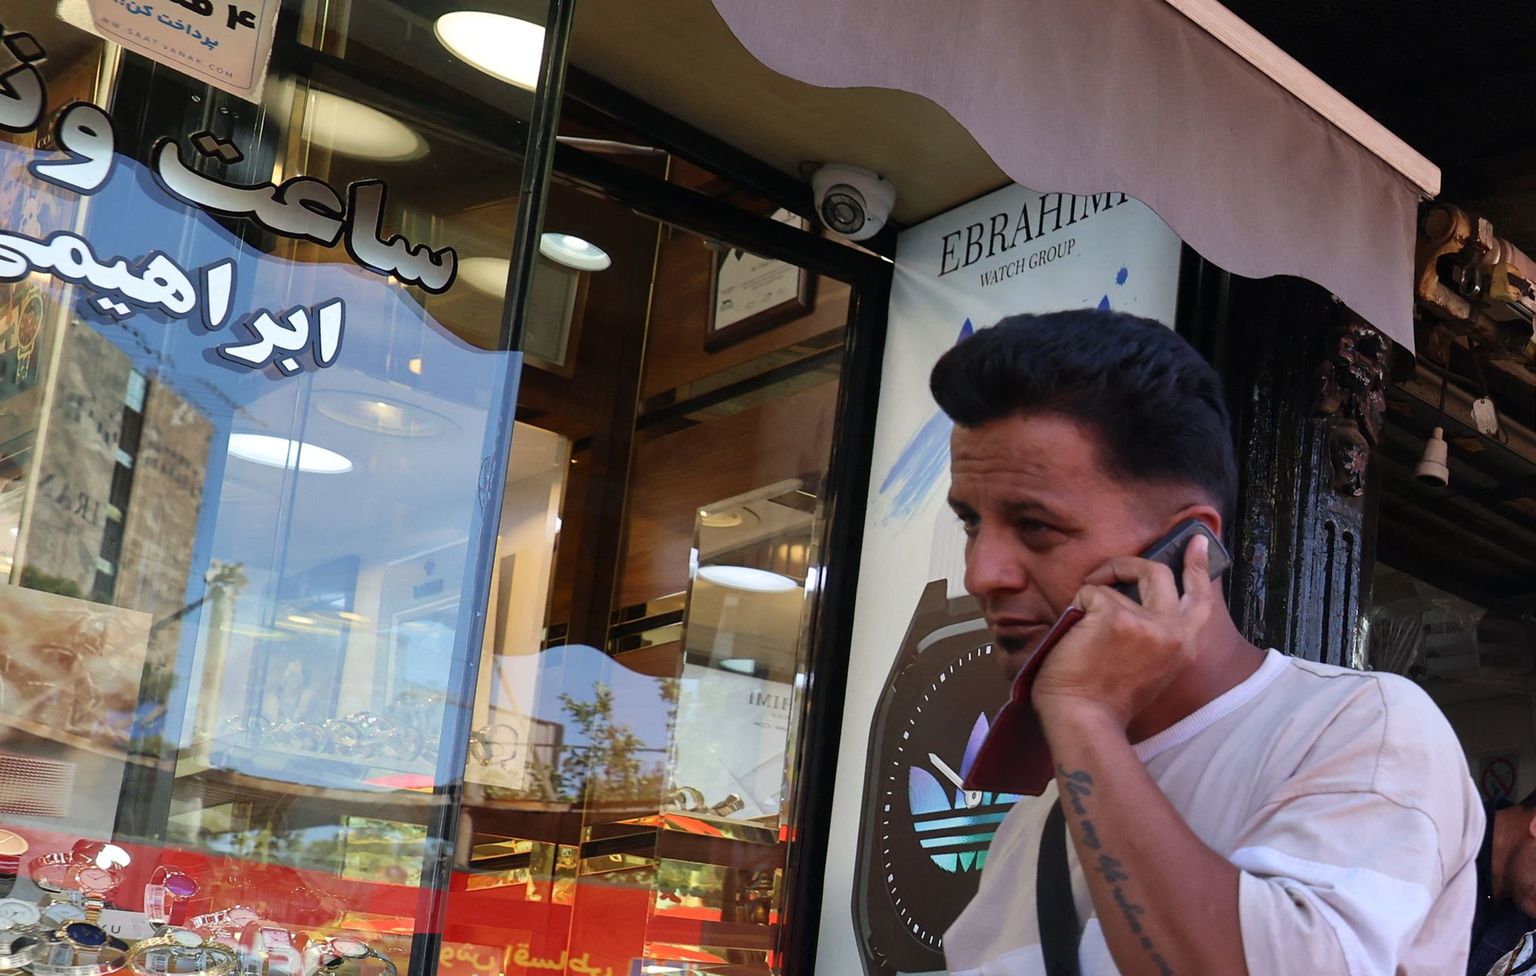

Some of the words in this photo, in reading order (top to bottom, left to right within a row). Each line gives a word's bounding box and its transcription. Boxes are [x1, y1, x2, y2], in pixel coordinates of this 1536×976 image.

[157, 14, 219, 50] پرداخت
[28, 102, 116, 195] و
[152, 131, 457, 294] ساعت
[980, 257, 1025, 288] WATCH
[1028, 238, 1077, 270] GROUP
